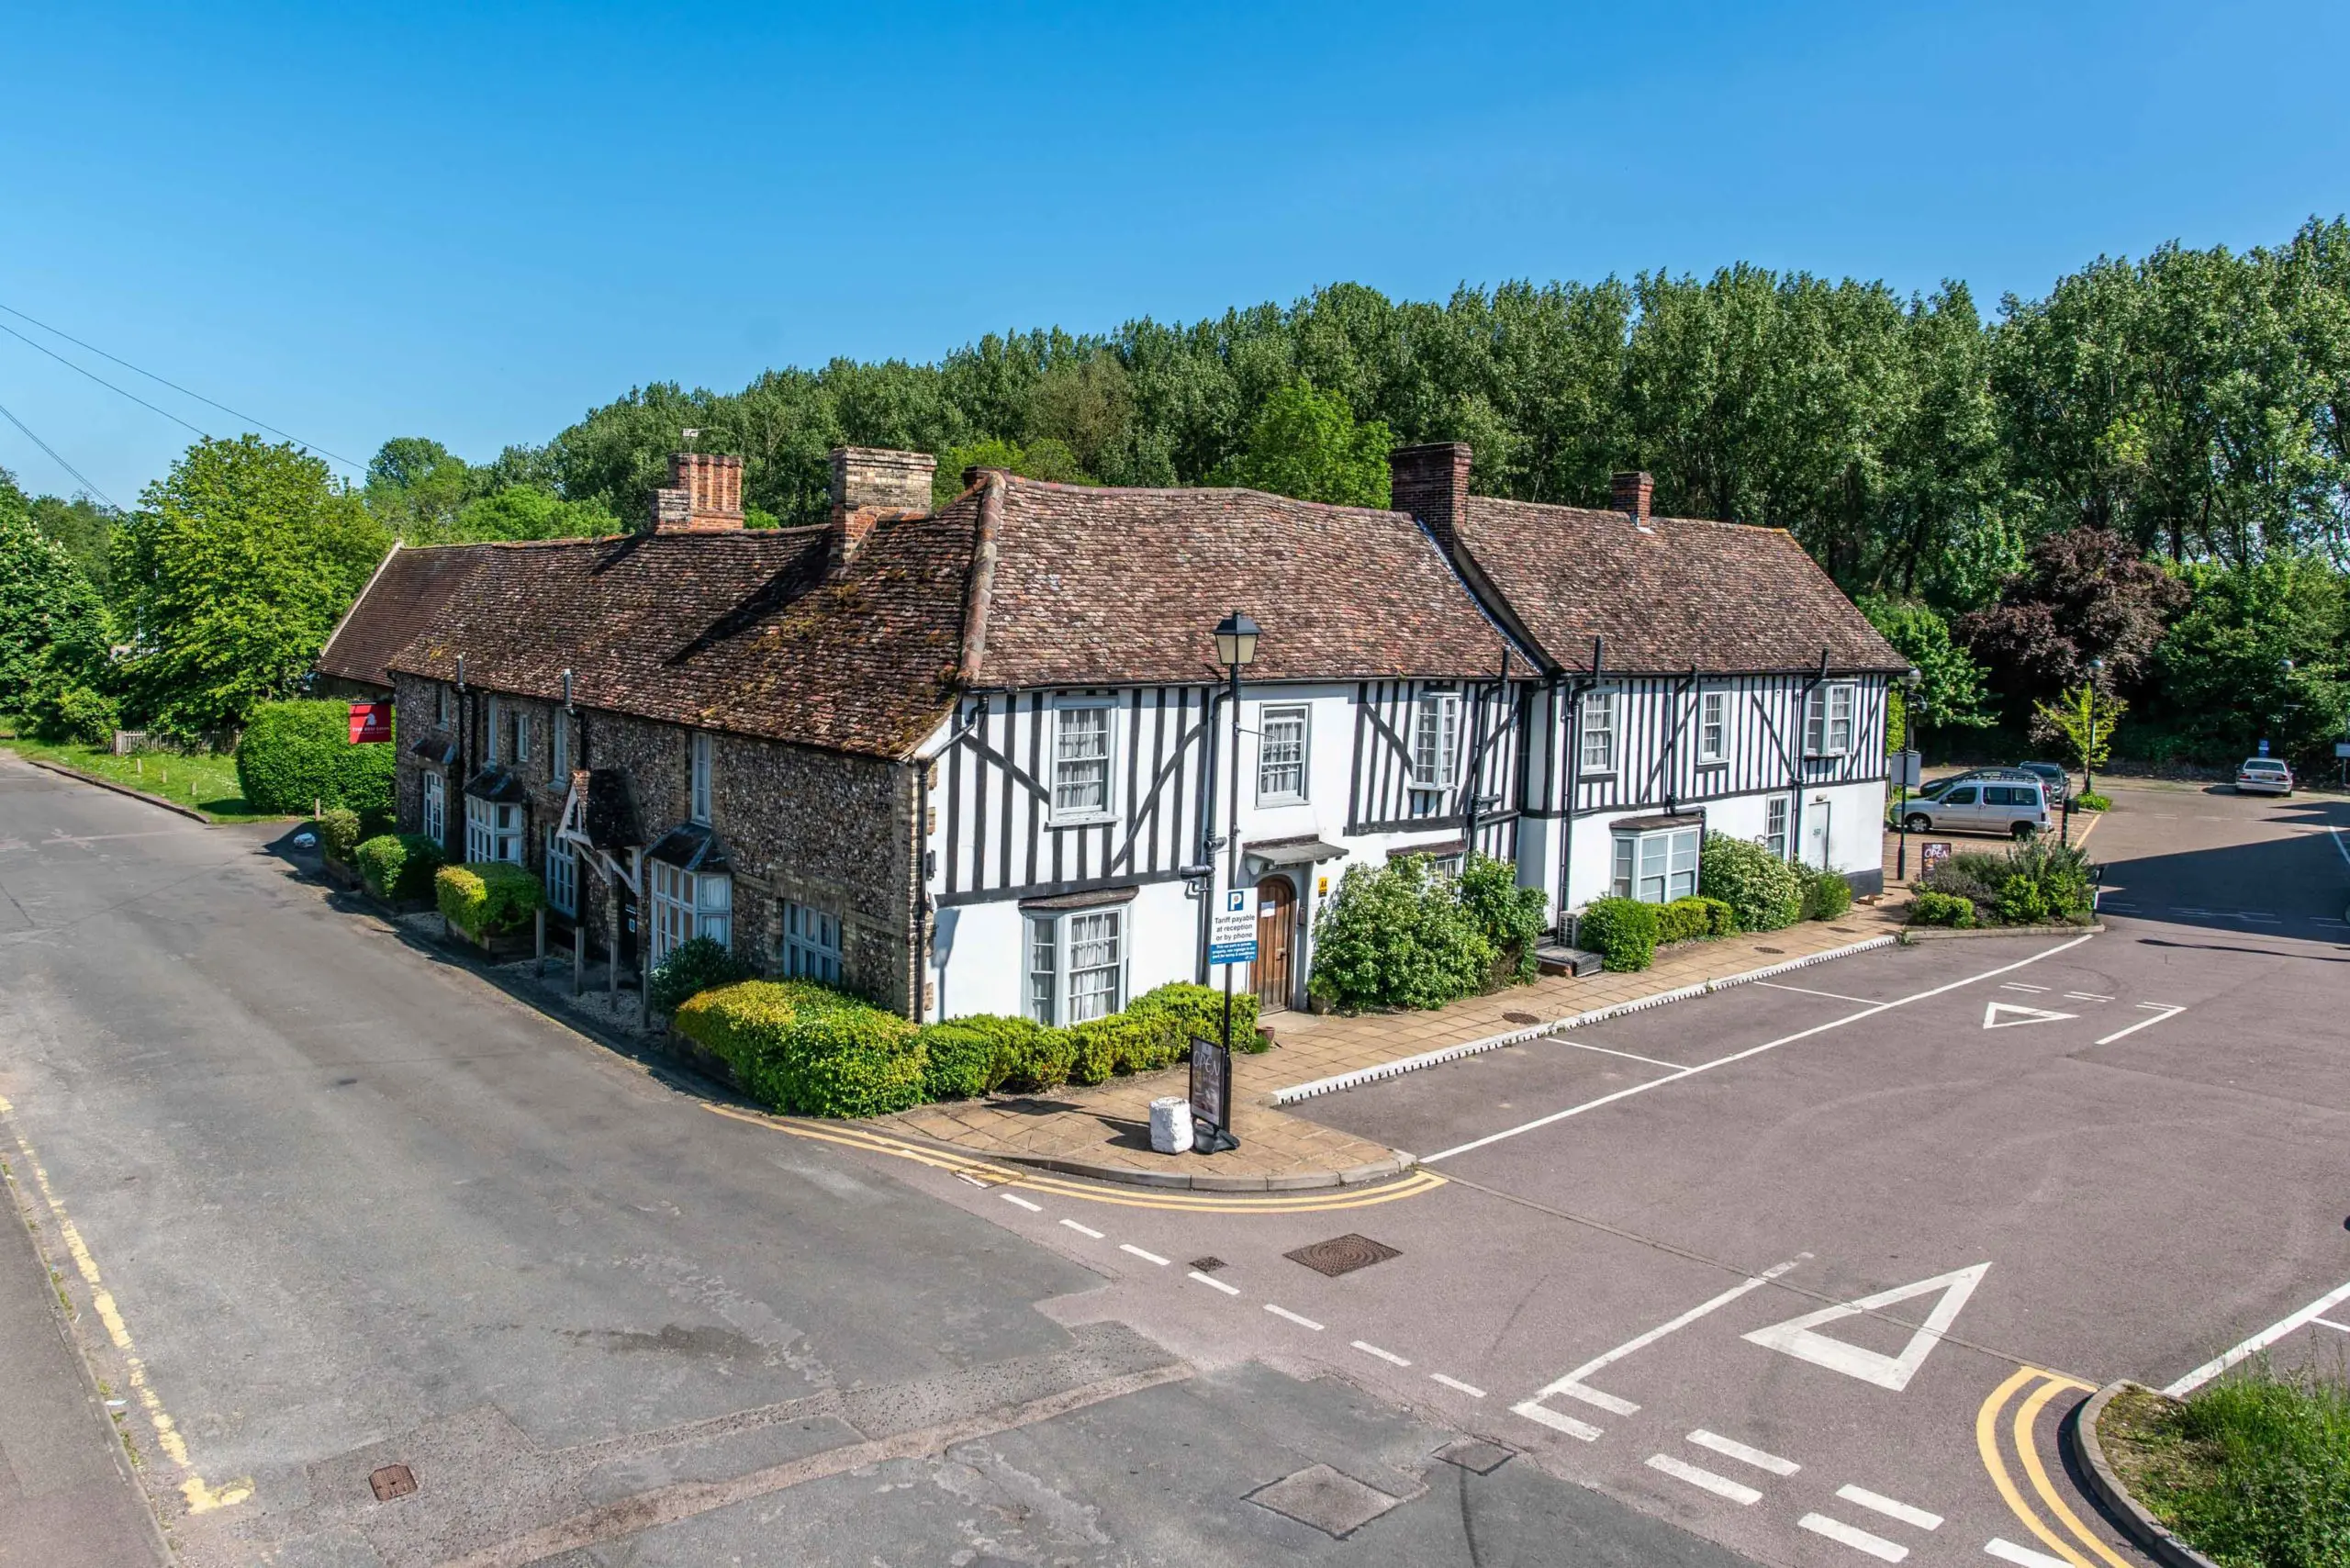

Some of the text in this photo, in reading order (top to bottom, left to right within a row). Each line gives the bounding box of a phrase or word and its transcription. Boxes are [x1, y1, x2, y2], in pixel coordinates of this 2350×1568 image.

[1924, 848, 1949, 858] OPEN
[1232, 914, 1255, 924] payable
[1224, 924, 1252, 932] reception
[1233, 932, 1252, 940] phone
[1193, 1050, 1221, 1077] OPEN
